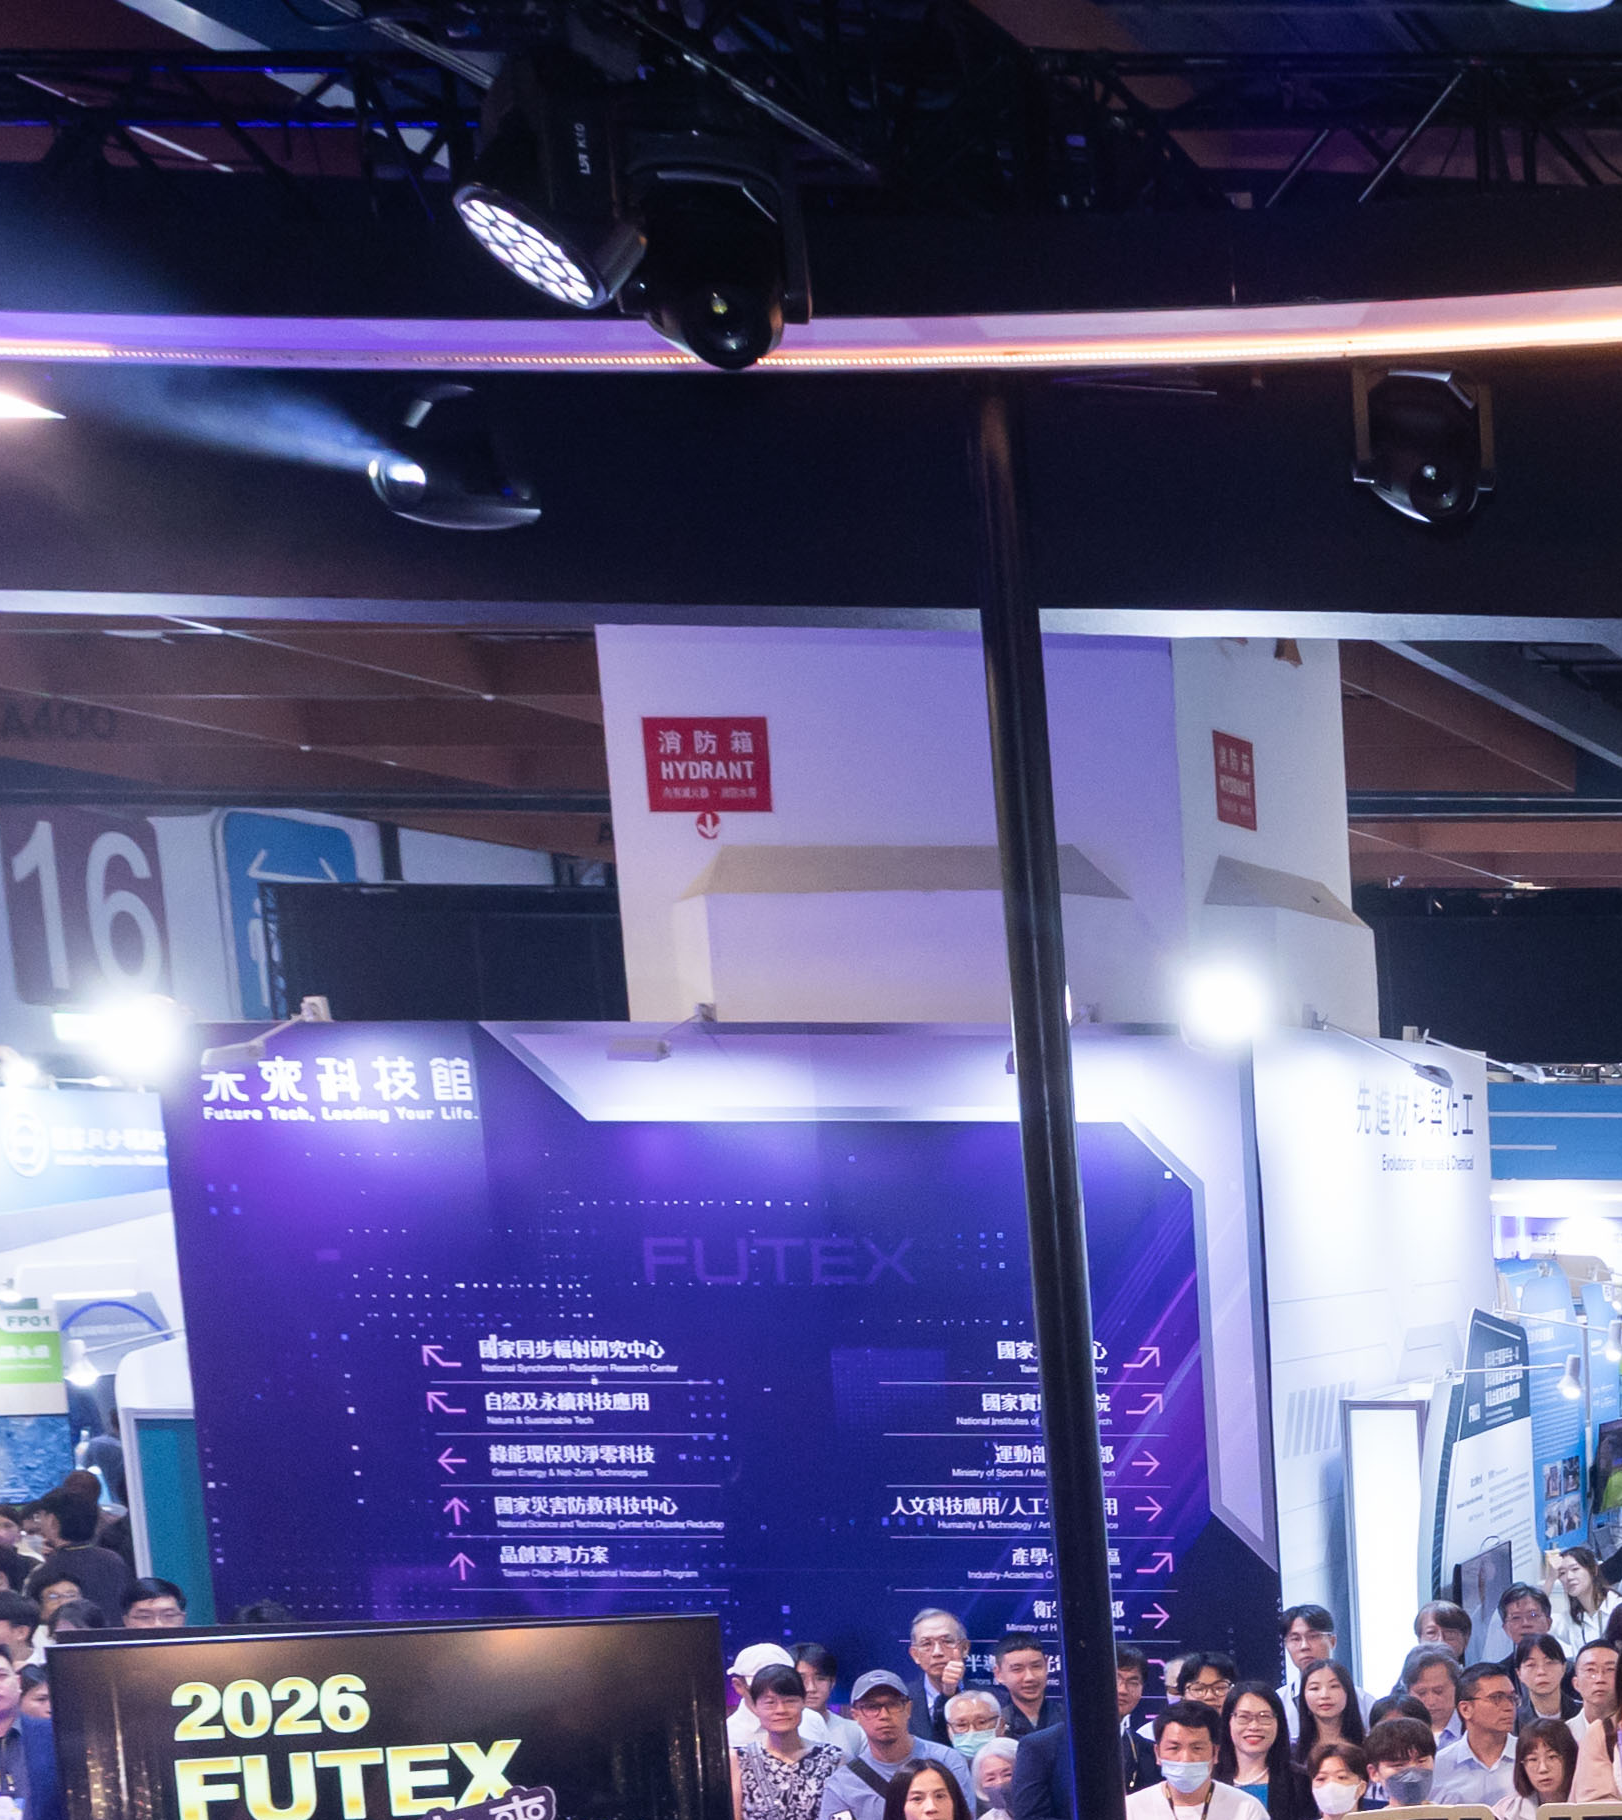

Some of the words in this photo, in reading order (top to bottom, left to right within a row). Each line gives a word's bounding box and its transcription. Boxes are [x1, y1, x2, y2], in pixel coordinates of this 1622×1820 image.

[658, 730, 753, 754] 消防箱
[661, 761, 754, 780] HYDRANT
[12, 821, 162, 995] 16
[201, 1056, 474, 1102] 未來科技館
[203, 1106, 262, 1120] Future
[270, 1106, 315, 1122] Tech,
[321, 1106, 389, 1123] Leading
[395, 1106, 434, 1120] Your
[440, 1106, 478, 1120] Life.
[641, 1237, 917, 1286] FUTEX
[484, 1392, 650, 1411] 自然及永續科技應用
[956, 1416, 989, 1427] National
[952, 1467, 984, 1479] Ministry
[996, 1467, 1023, 1479] Sports
[494, 1496, 678, 1516] 國家災害防救科技中心
[937, 1519, 976, 1530] Humanity
[986, 1519, 1032, 1531] Technology
[499, 1545, 609, 1564] 晶創臺灣方案
[1006, 1622, 1038, 1634] Ministry
[171, 1673, 371, 1742] 2026
